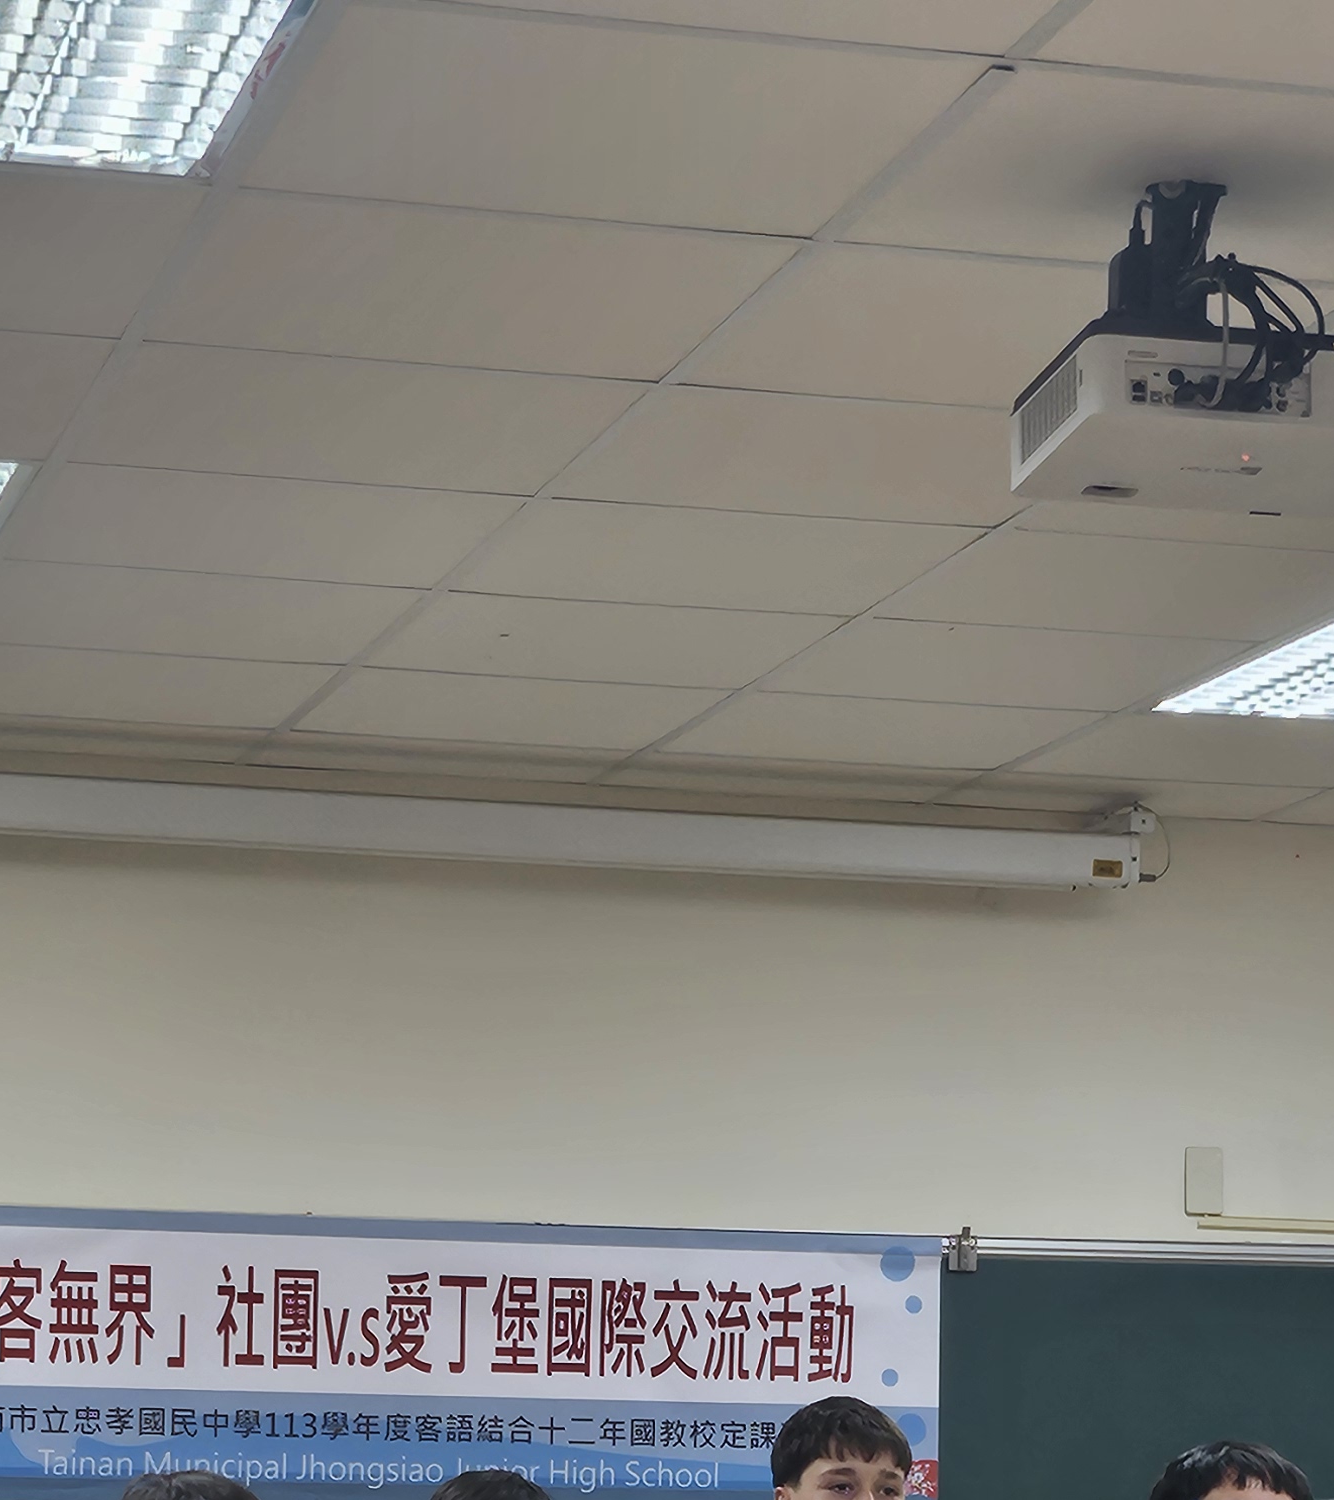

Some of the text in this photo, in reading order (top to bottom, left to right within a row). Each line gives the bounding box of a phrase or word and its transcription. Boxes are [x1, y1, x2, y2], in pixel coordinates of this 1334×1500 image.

[38, 1449, 133, 1476] Tainan
[295, 1454, 444, 1490] Jhongsiao
[549, 1459, 615, 1493] High
[625, 1461, 719, 1489] School
